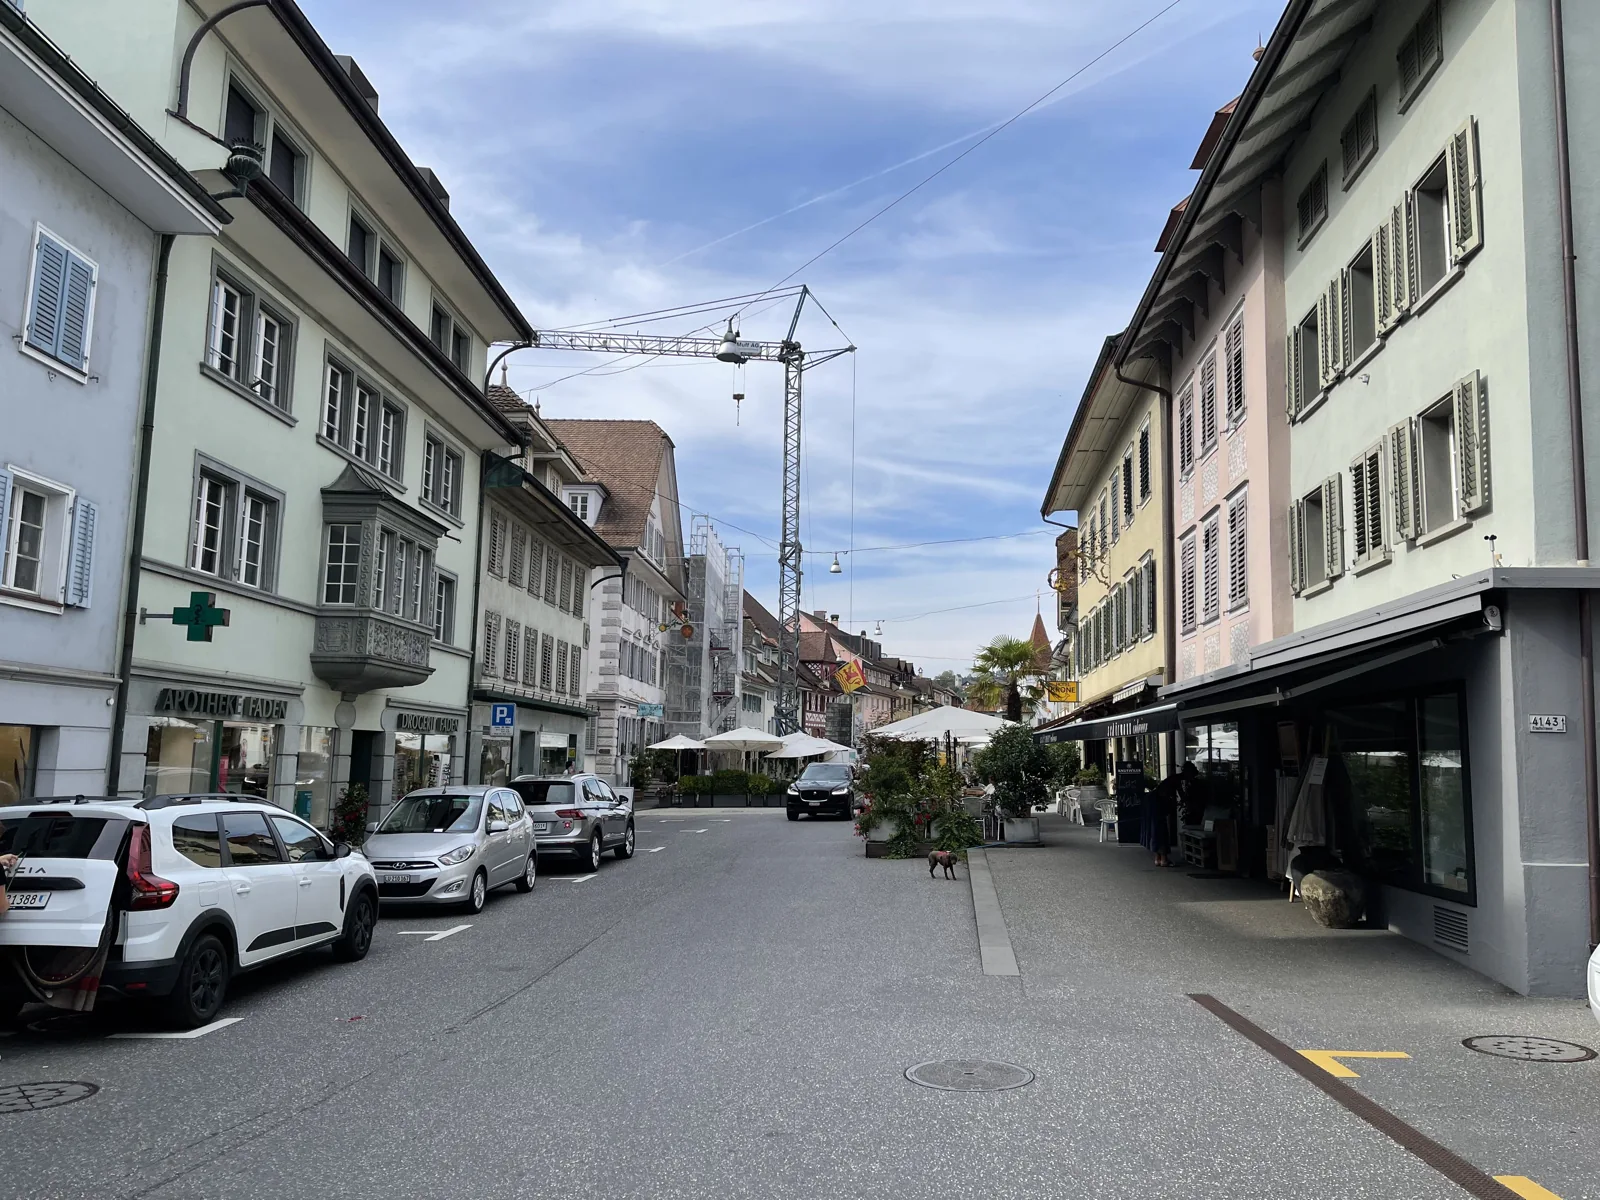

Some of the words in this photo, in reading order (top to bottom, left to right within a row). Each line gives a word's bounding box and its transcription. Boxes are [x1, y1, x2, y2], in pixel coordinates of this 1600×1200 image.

[1050, 685, 1076, 694] KRONE
[163, 688, 245, 717] APOTHEKE
[249, 696, 288, 719] FADEN
[495, 706, 508, 723] P
[440, 717, 459, 732] FADEN
